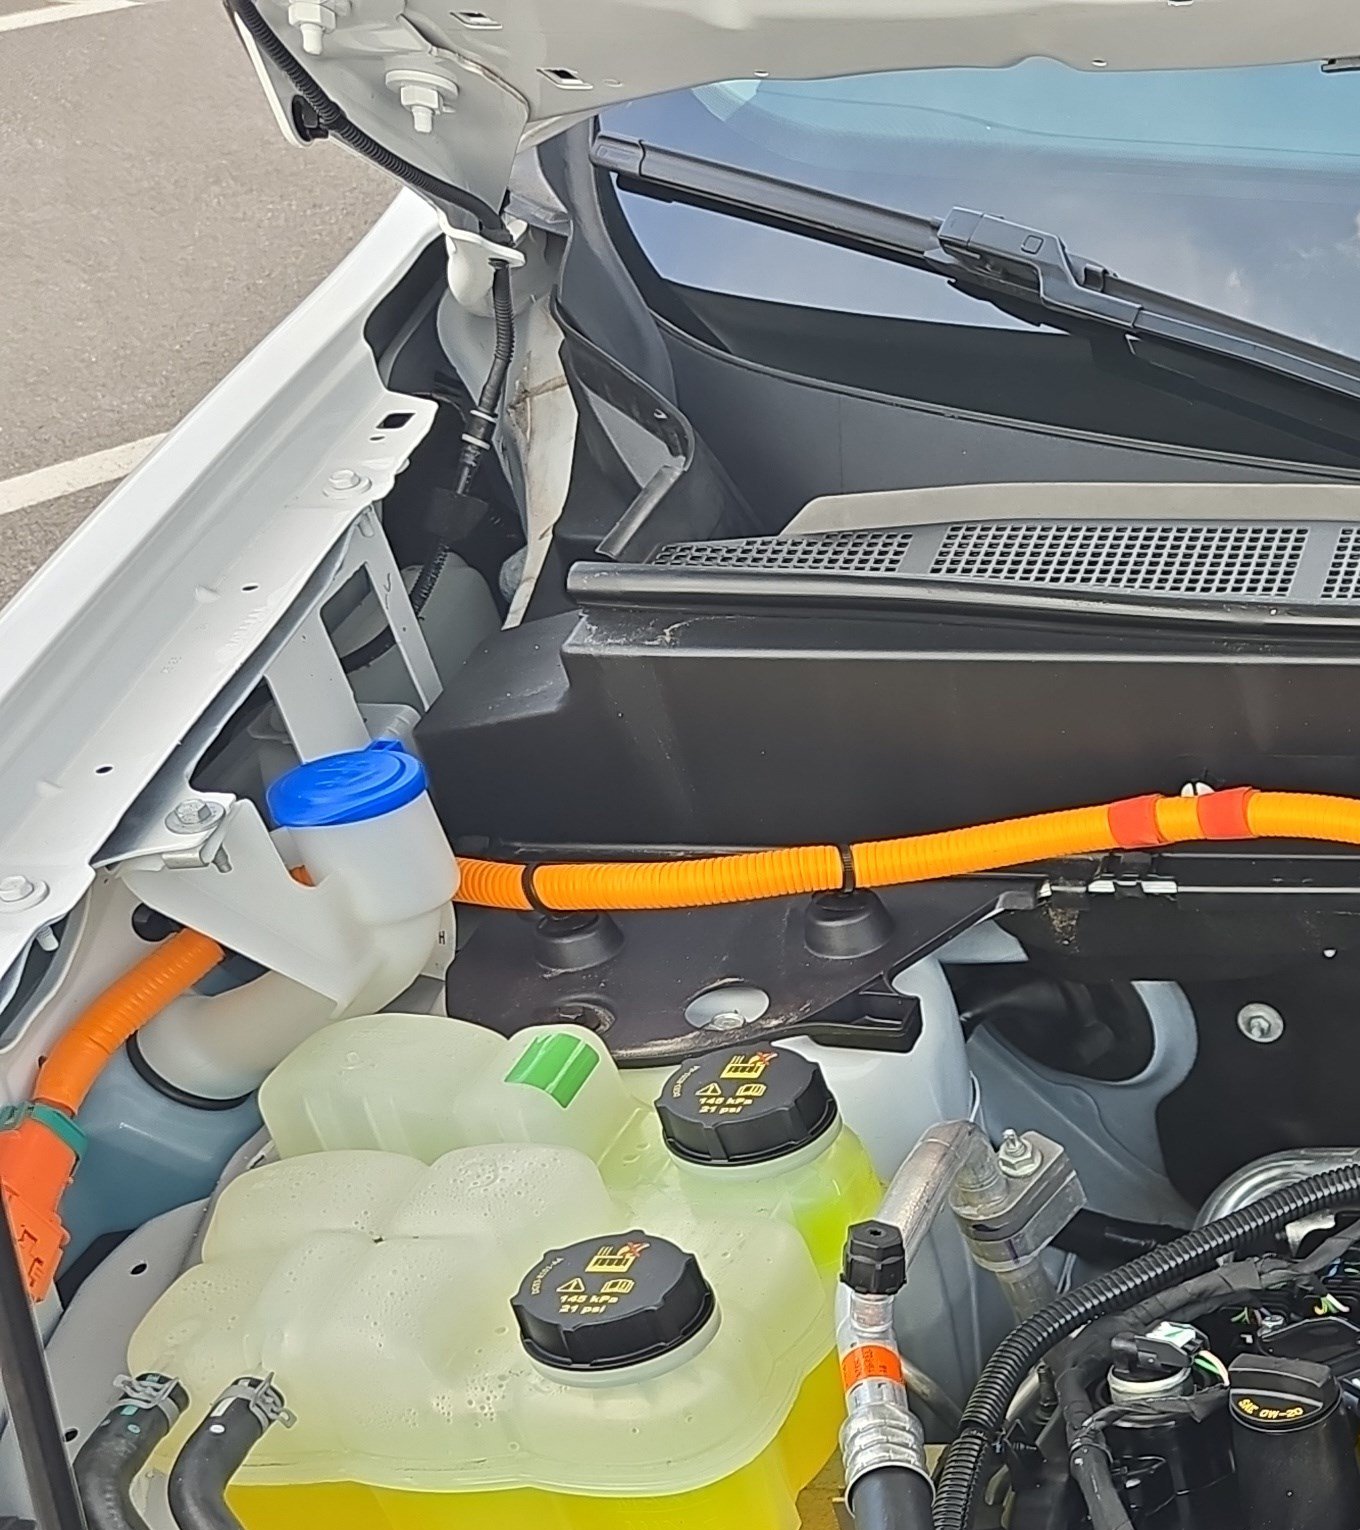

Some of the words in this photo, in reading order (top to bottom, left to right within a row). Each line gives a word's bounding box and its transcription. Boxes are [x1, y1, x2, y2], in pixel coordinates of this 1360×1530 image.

[718, 1106, 742, 1115] psi
[559, 1295, 584, 1303] 145
[589, 1295, 619, 1304] kPa
[559, 1305, 578, 1314] 21
[580, 1305, 606, 1315] psi
[1238, 1398, 1260, 1415] SAE
